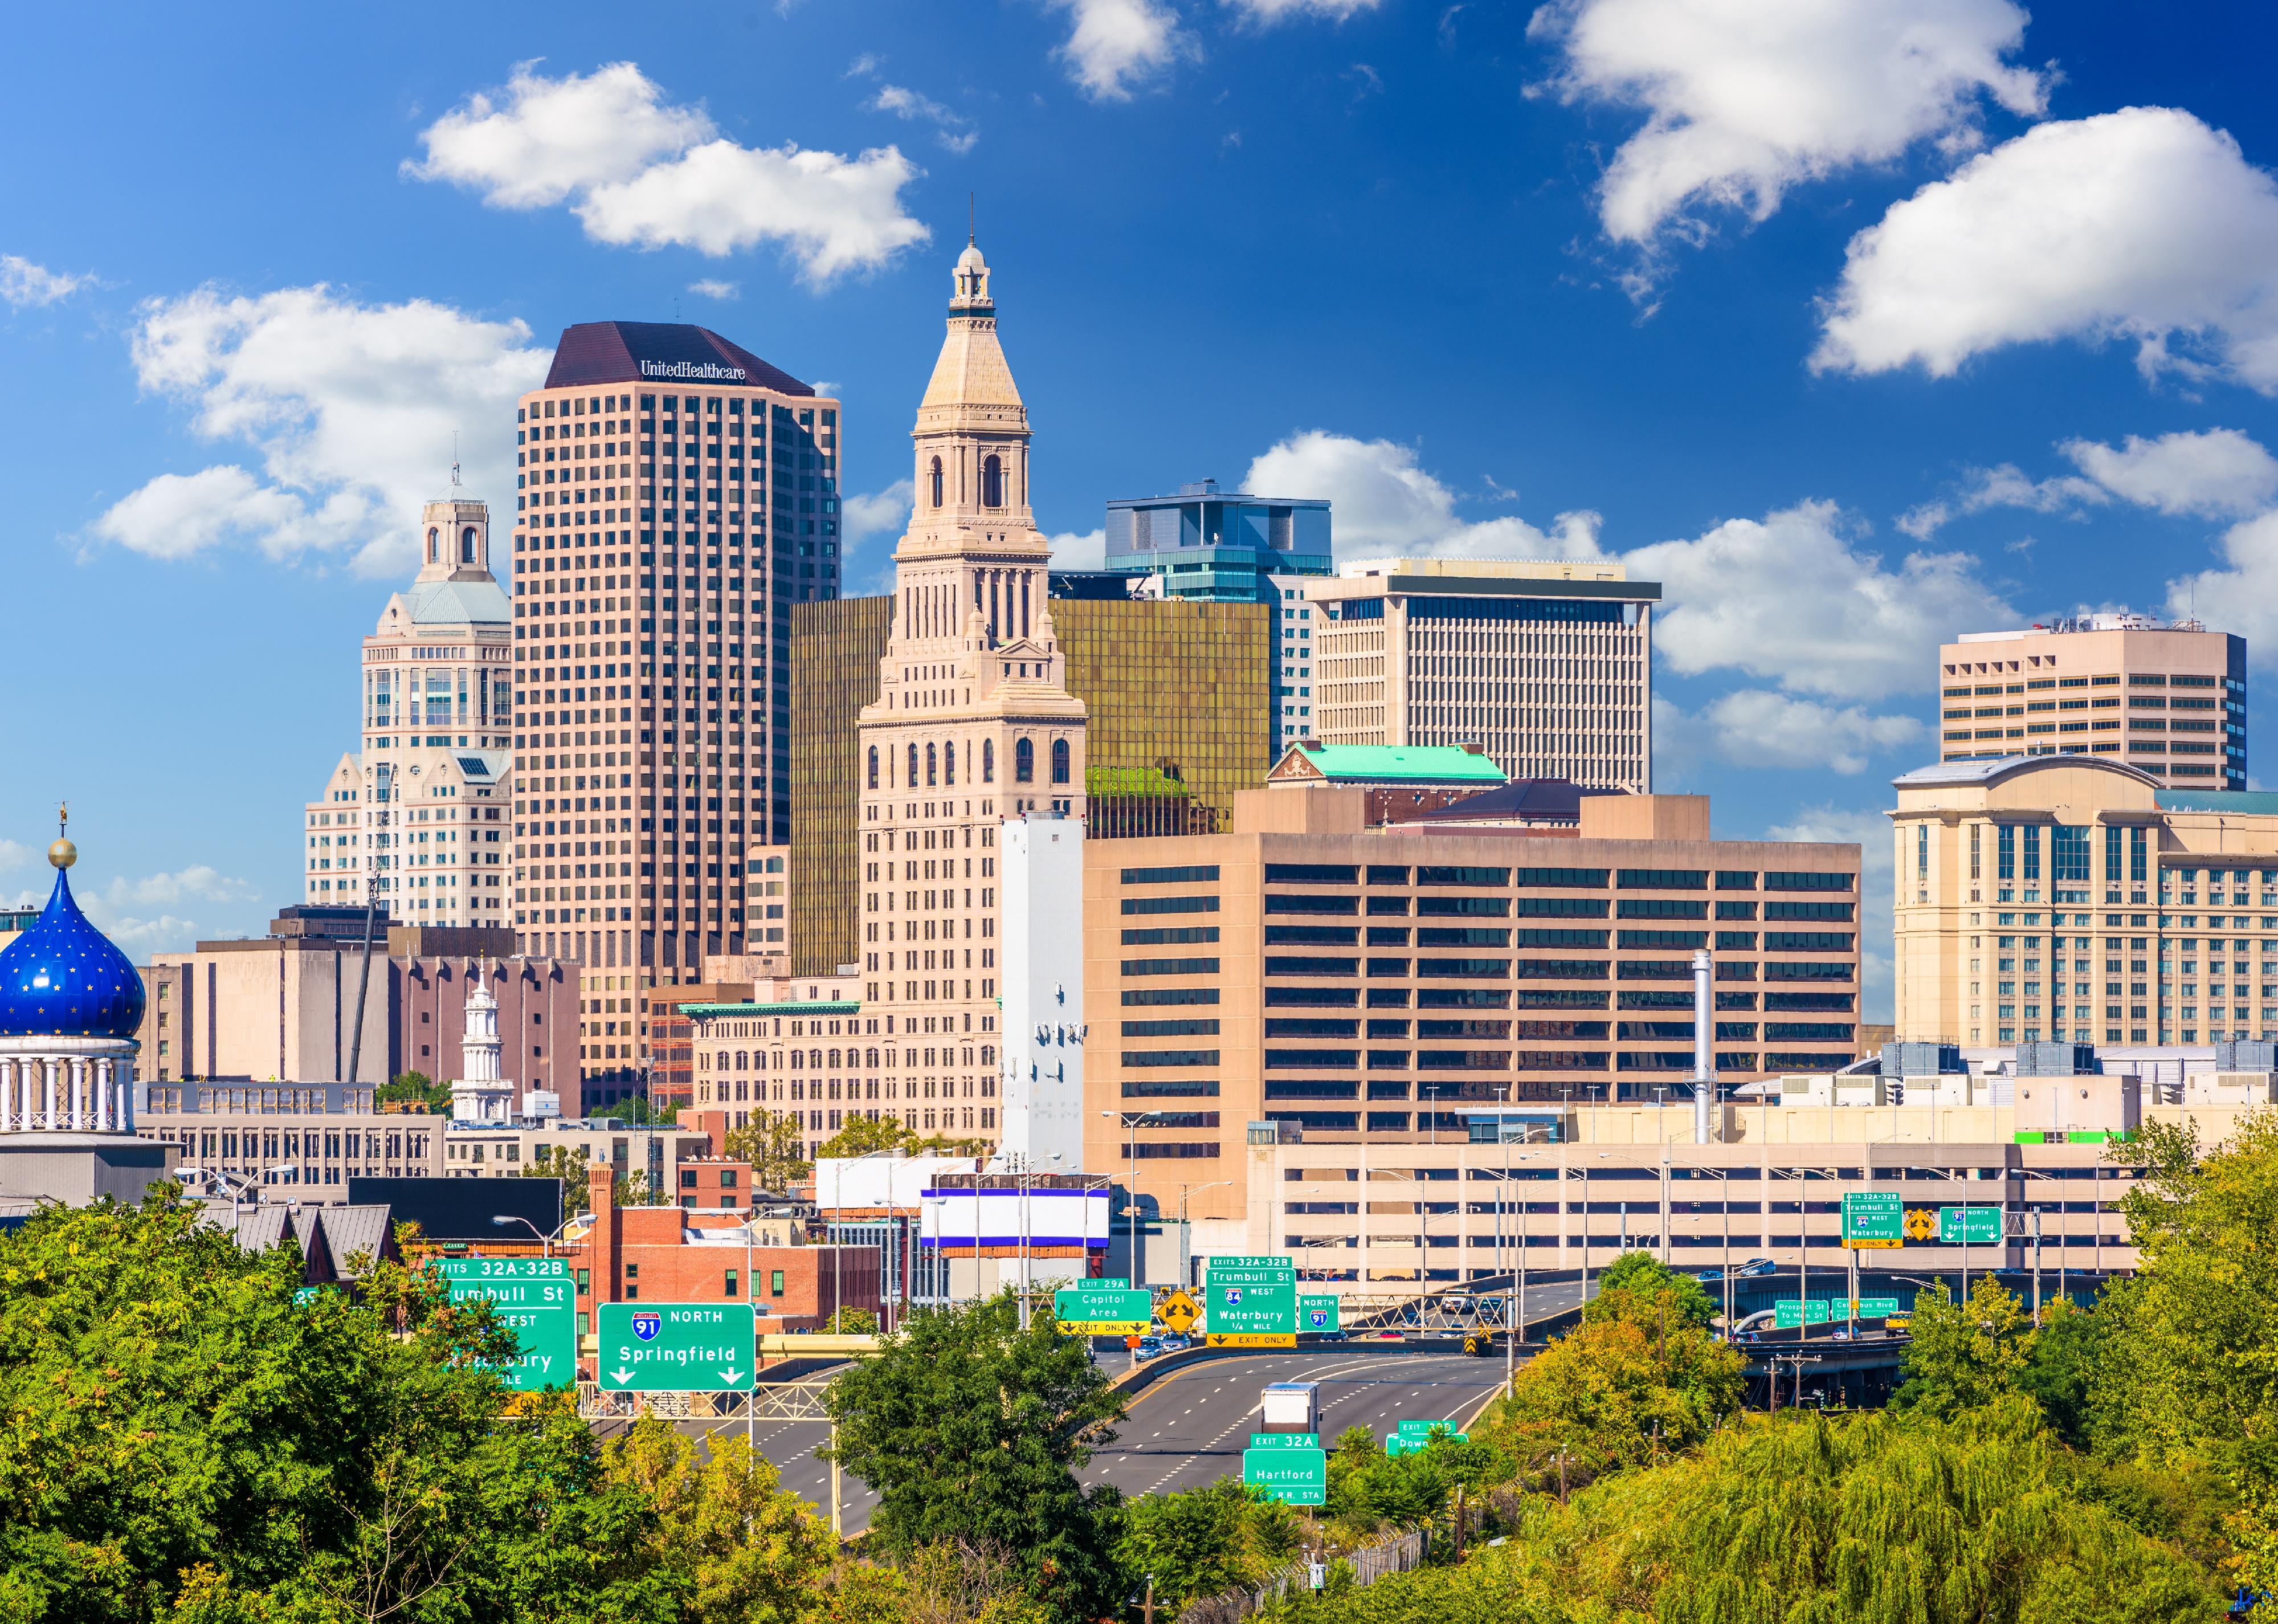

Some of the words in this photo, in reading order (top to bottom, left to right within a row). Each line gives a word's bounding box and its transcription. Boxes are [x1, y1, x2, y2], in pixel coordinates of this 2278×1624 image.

[640, 360, 745, 380] UnitedHealthcare
[481, 1261, 562, 1276] 32A-32B
[1213, 1272, 1267, 1282] Trumbull
[1277, 1272, 1289, 1282] St
[1104, 1280, 1125, 1288] 29A
[447, 1286, 525, 1301] umbull
[543, 1286, 564, 1301] St
[1226, 1292, 1240, 1301] 84
[1082, 1295, 1124, 1305] Capitol
[671, 1311, 722, 1322] NORTH
[1089, 1308, 1117, 1317] Area
[1219, 1311, 1283, 1323] Waterbury
[1313, 1315, 1324, 1323] 91
[635, 1321, 655, 1335] 91
[619, 1346, 736, 1366] Springfield
[1284, 1435, 1313, 1447] 32A
[1256, 1469, 1313, 1480] Hartford
